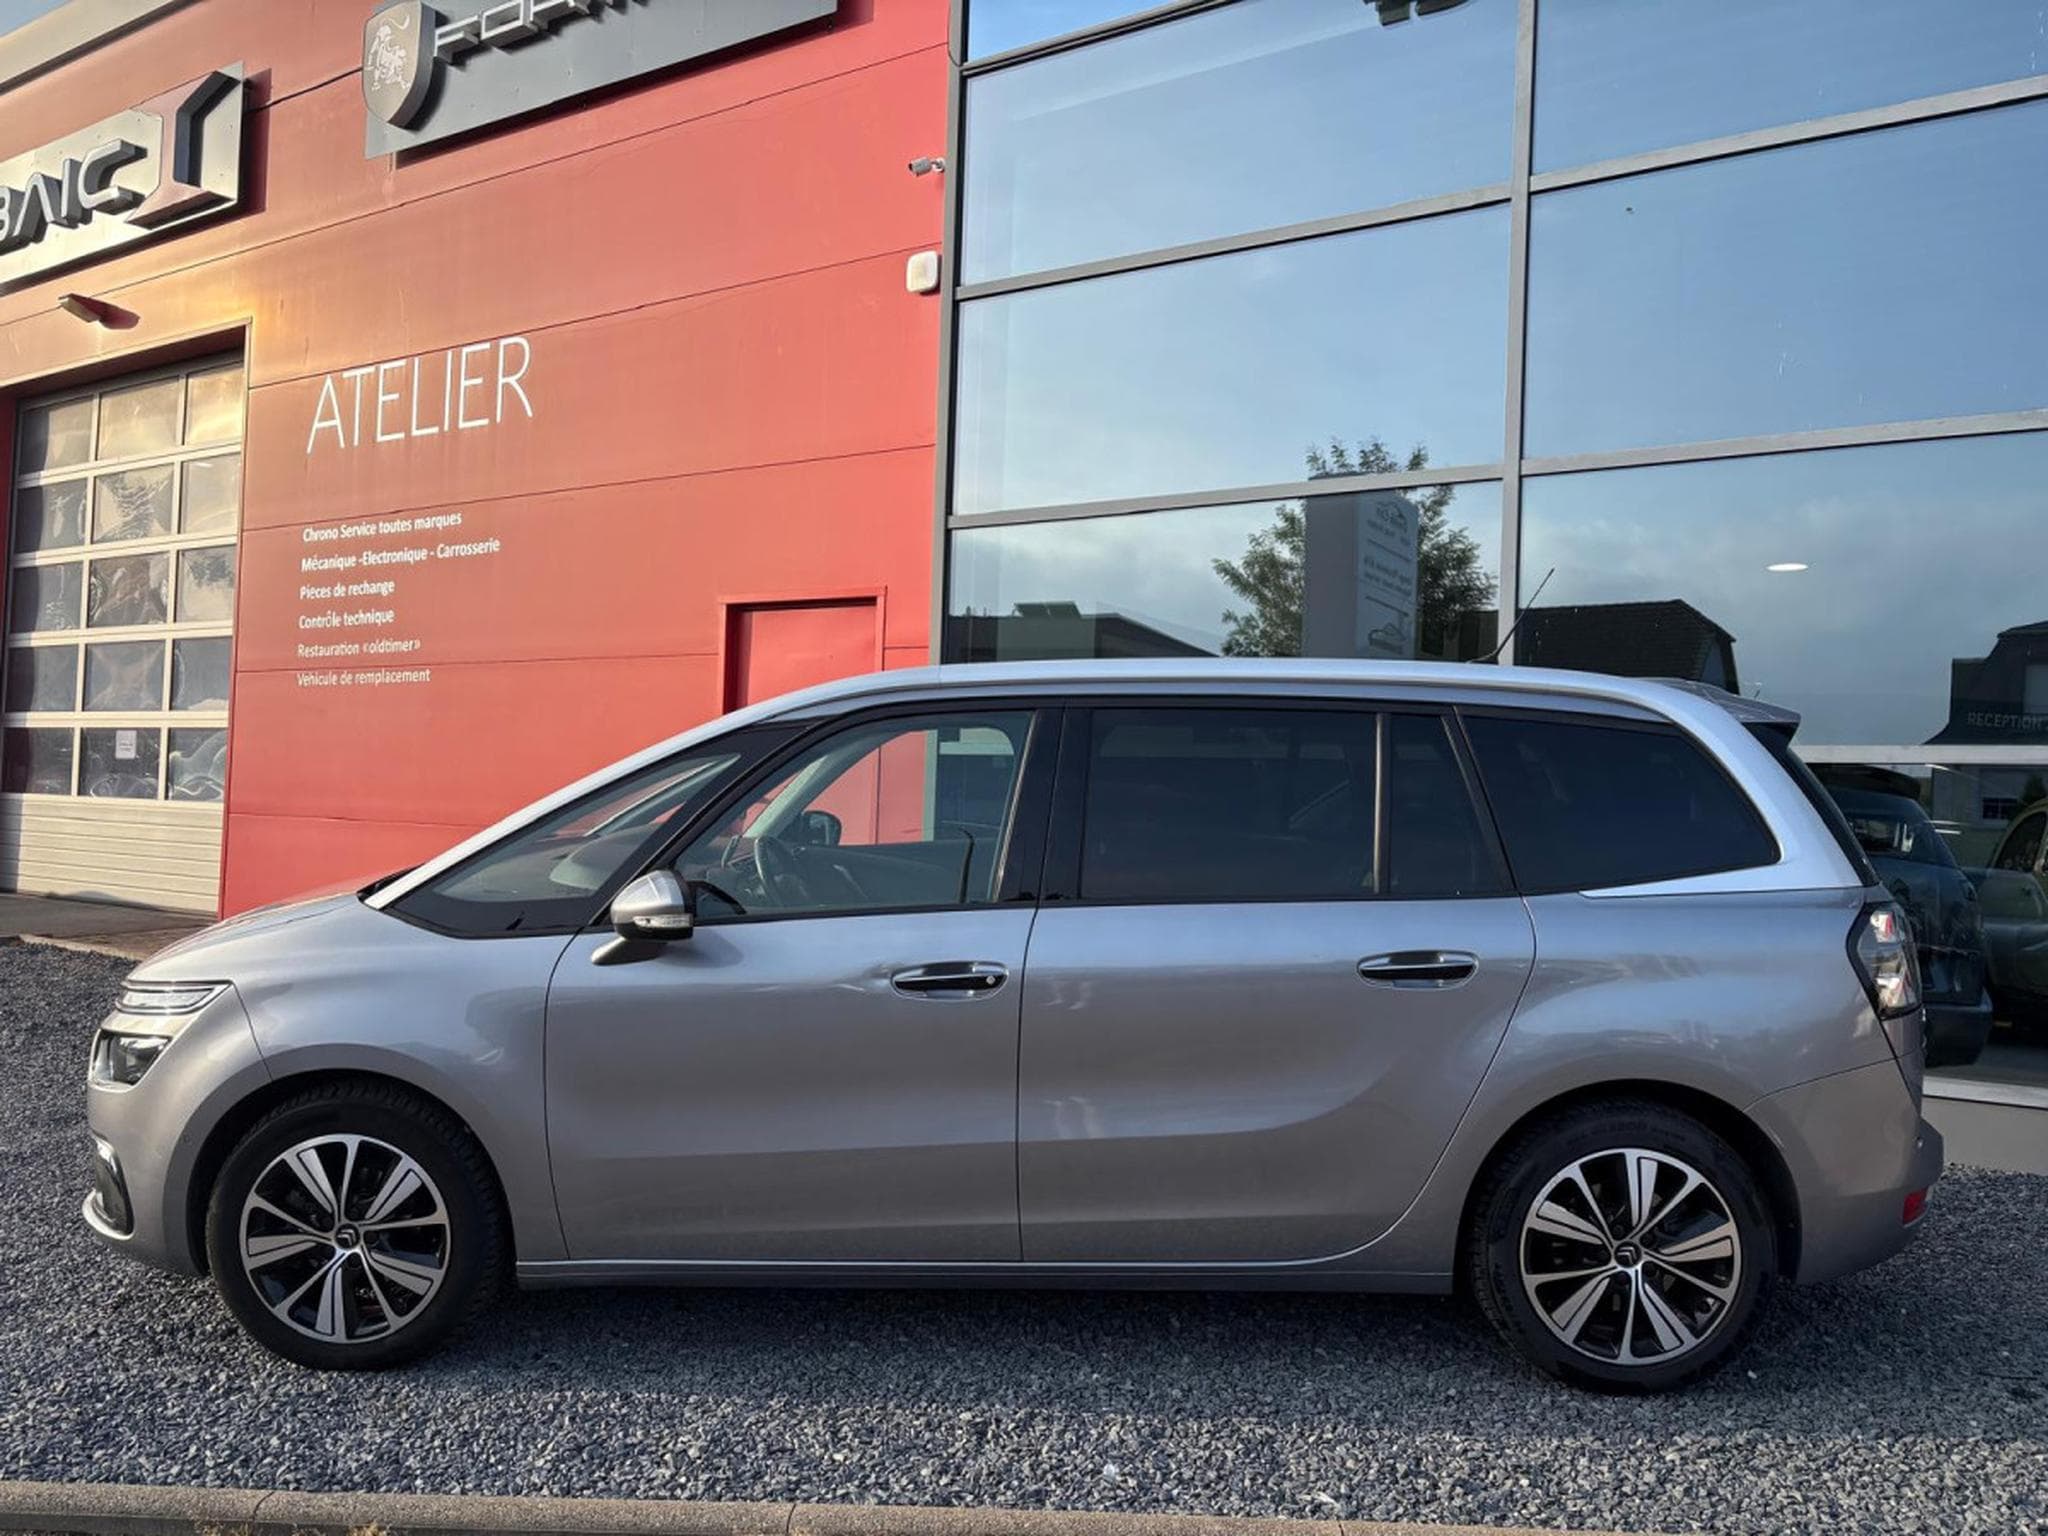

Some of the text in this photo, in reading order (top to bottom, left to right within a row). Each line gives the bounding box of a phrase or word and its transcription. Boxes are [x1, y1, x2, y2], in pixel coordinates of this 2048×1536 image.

[306, 335, 533, 454] ATELIER
[303, 512, 463, 542] Chrono Service toutes marques
[436, 538, 501, 559] Carrosserie
[333, 582, 347, 597] de
[348, 580, 395, 597] rechange
[299, 608, 395, 629] Contrôle technique
[297, 641, 360, 658] Restauration
[340, 671, 353, 685] de
[354, 668, 431, 687] remplacement
